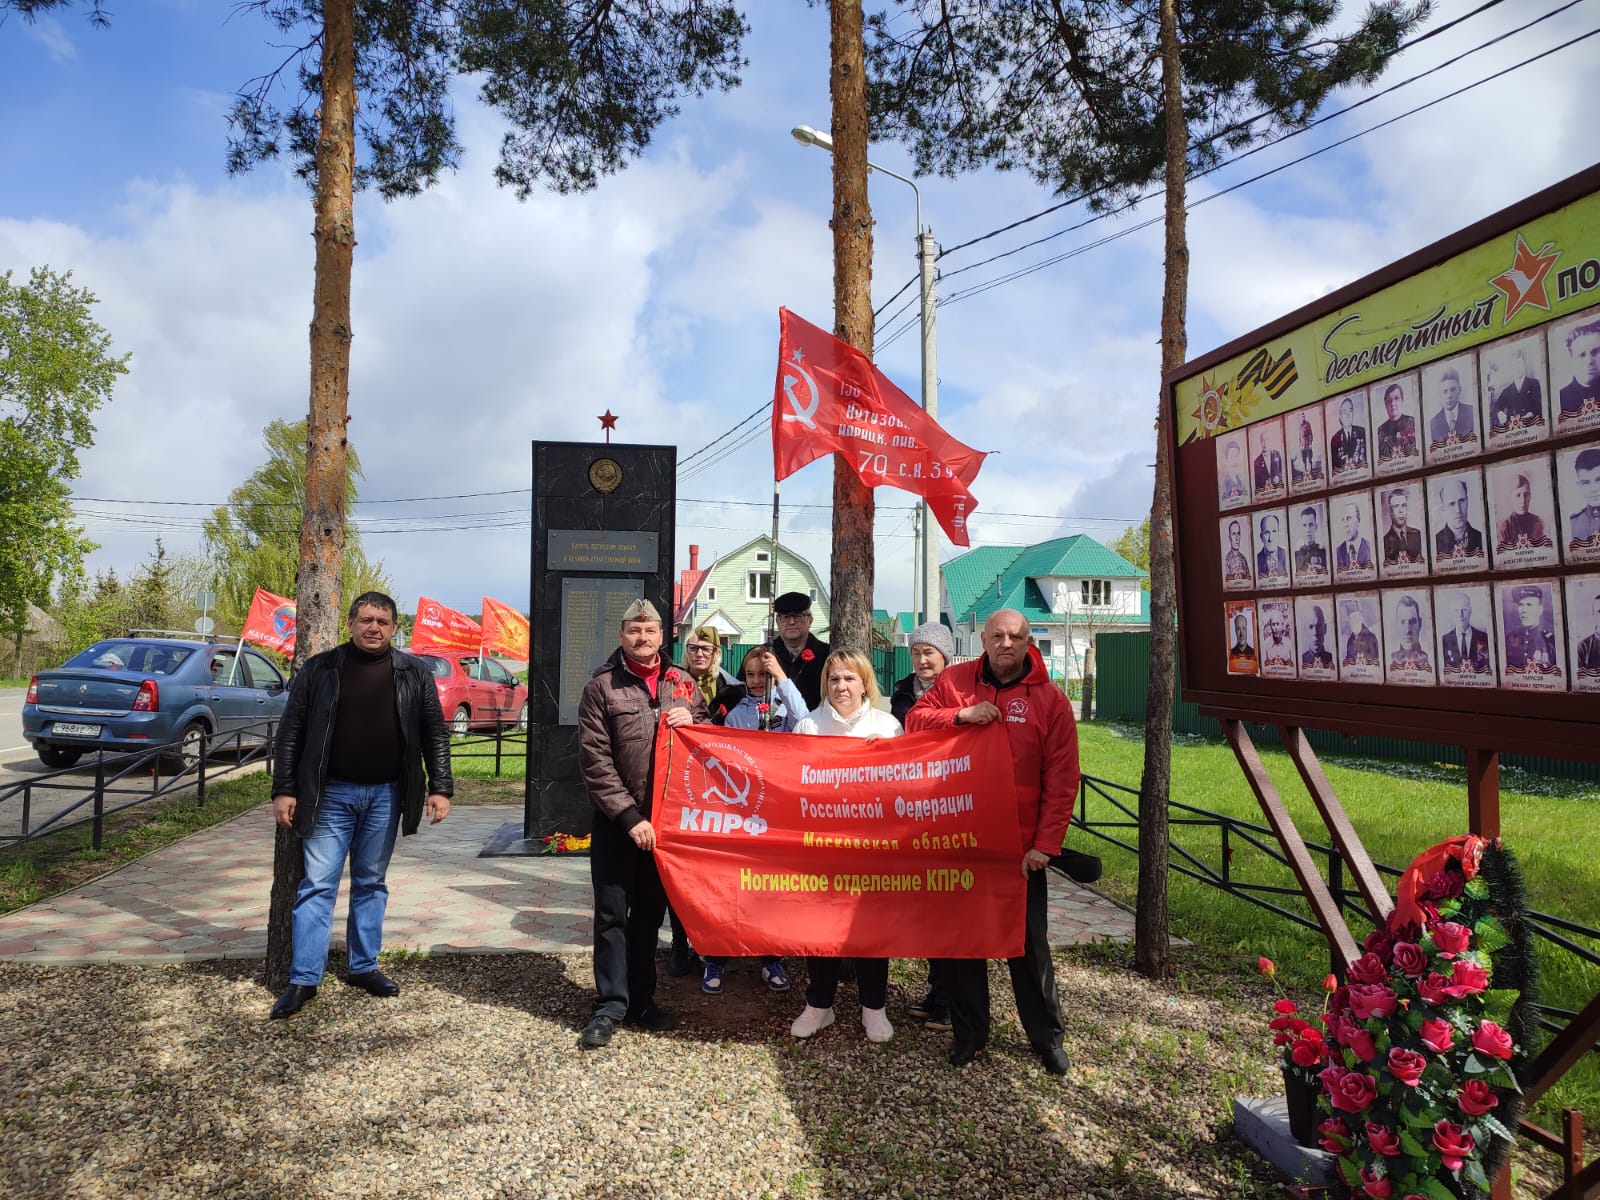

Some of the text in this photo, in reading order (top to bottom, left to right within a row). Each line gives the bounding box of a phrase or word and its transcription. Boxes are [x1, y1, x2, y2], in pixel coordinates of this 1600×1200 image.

[801, 755, 971, 789] Коммунистическая партия
[680, 806, 768, 836] КПРФ
[800, 793, 974, 822] Российской Федерации
[803, 832, 978, 850] Московская область
[740, 868, 975, 896] Ногинское отделение КПРФ
